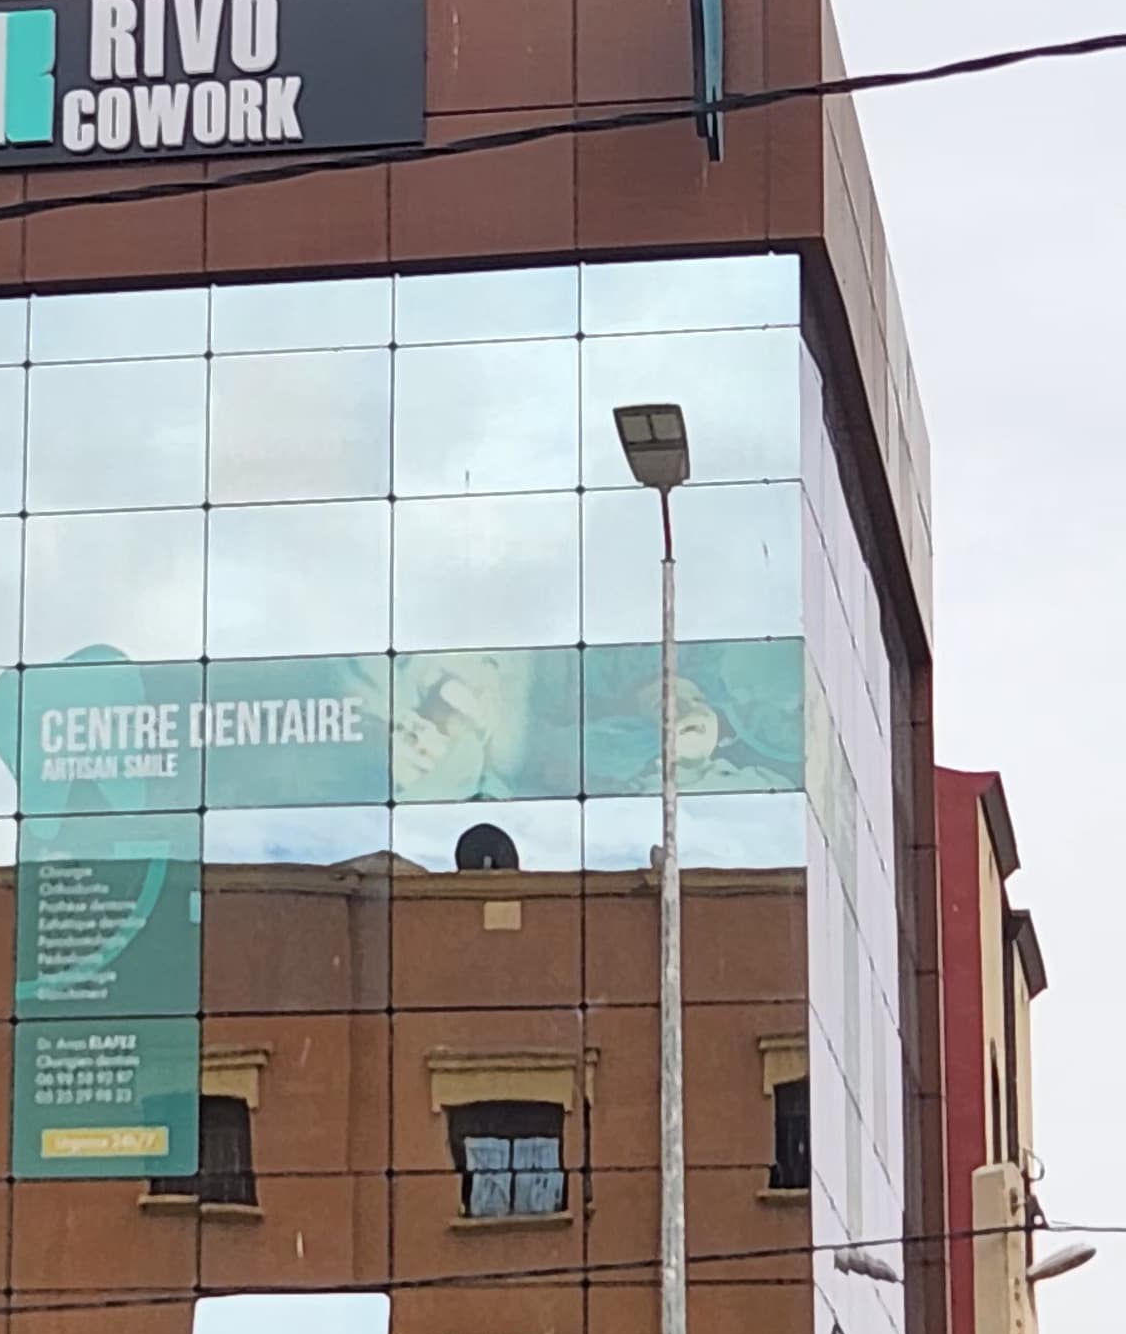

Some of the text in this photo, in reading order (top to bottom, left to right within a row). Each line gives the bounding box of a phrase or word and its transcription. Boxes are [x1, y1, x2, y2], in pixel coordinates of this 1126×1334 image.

[62, 76, 303, 152] COWORK
[40, 697, 364, 753] CENTRE DENTAIRE
[41, 752, 179, 781] ARTISAN SMILE
